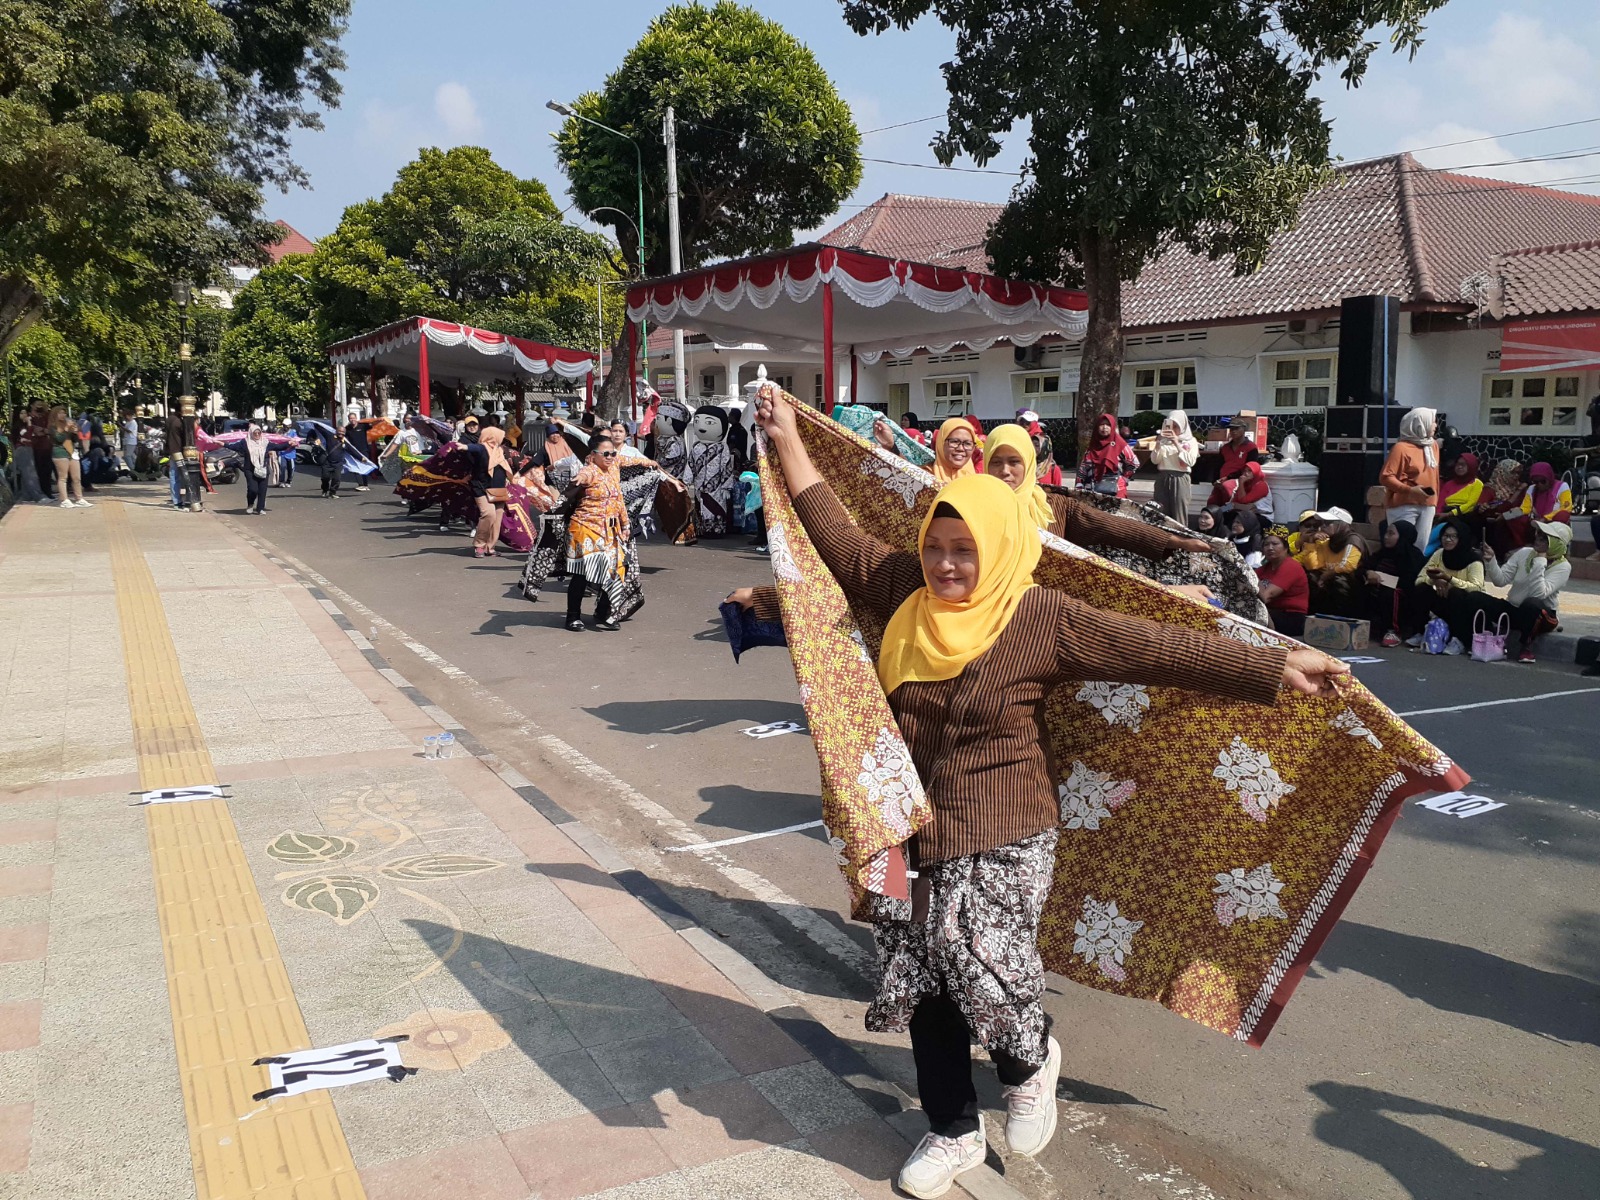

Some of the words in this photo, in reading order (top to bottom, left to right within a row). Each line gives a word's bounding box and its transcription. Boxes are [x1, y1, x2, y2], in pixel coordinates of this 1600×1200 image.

[1565, 322, 1597, 330] INDONESIA
[1436, 797, 1490, 813] 10
[281, 1047, 388, 1086] 12
